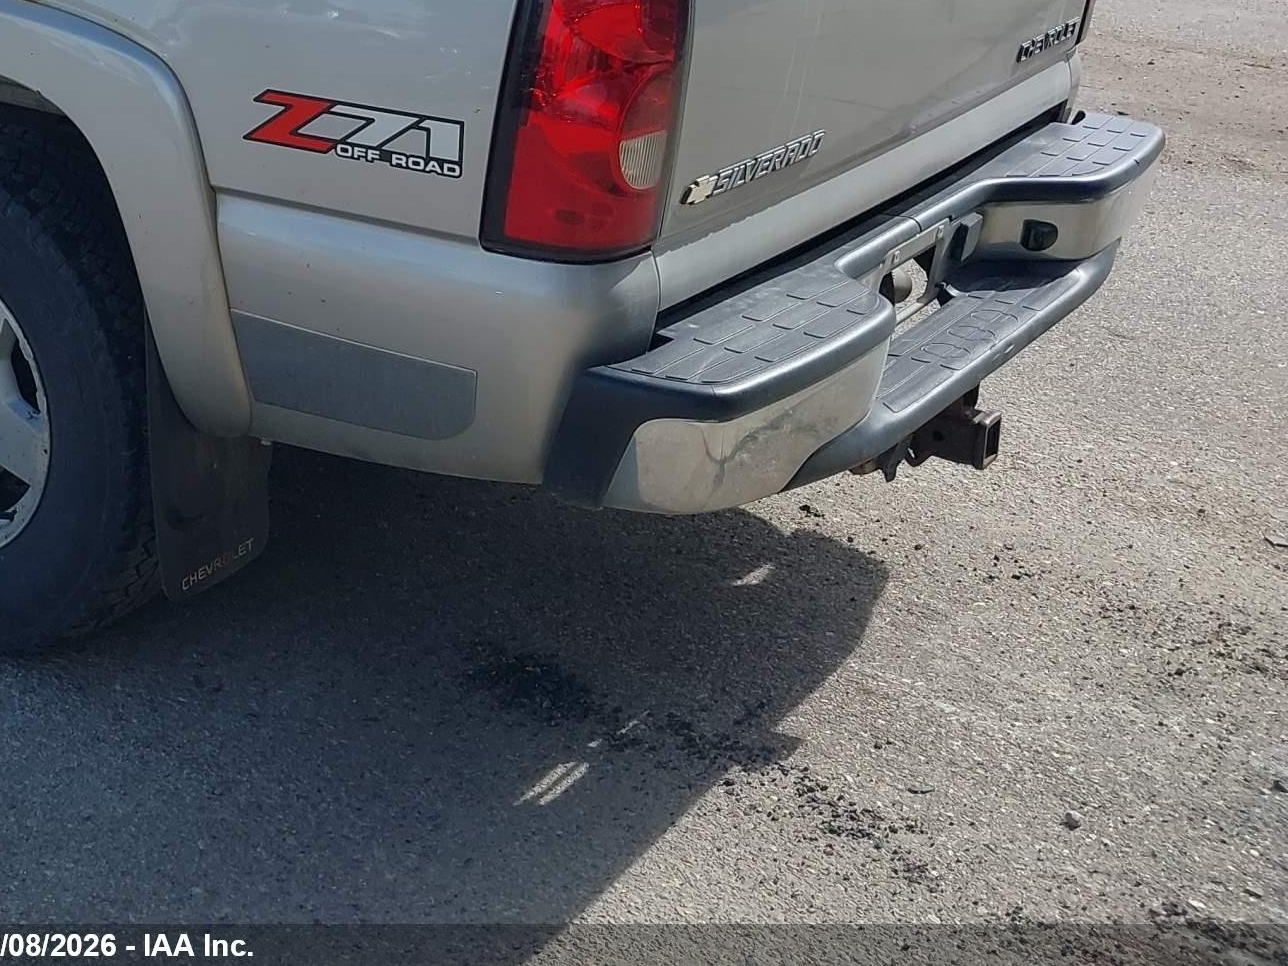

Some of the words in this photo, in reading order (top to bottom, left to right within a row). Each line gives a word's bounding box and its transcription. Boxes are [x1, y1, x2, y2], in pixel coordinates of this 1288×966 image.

[1016, 17, 1080, 63] CHEVROLET
[243, 89, 465, 154] Z71
[335, 143, 382, 163] OFF
[390, 154, 462, 178] ROAD
[712, 129, 826, 196] SILVERADO
